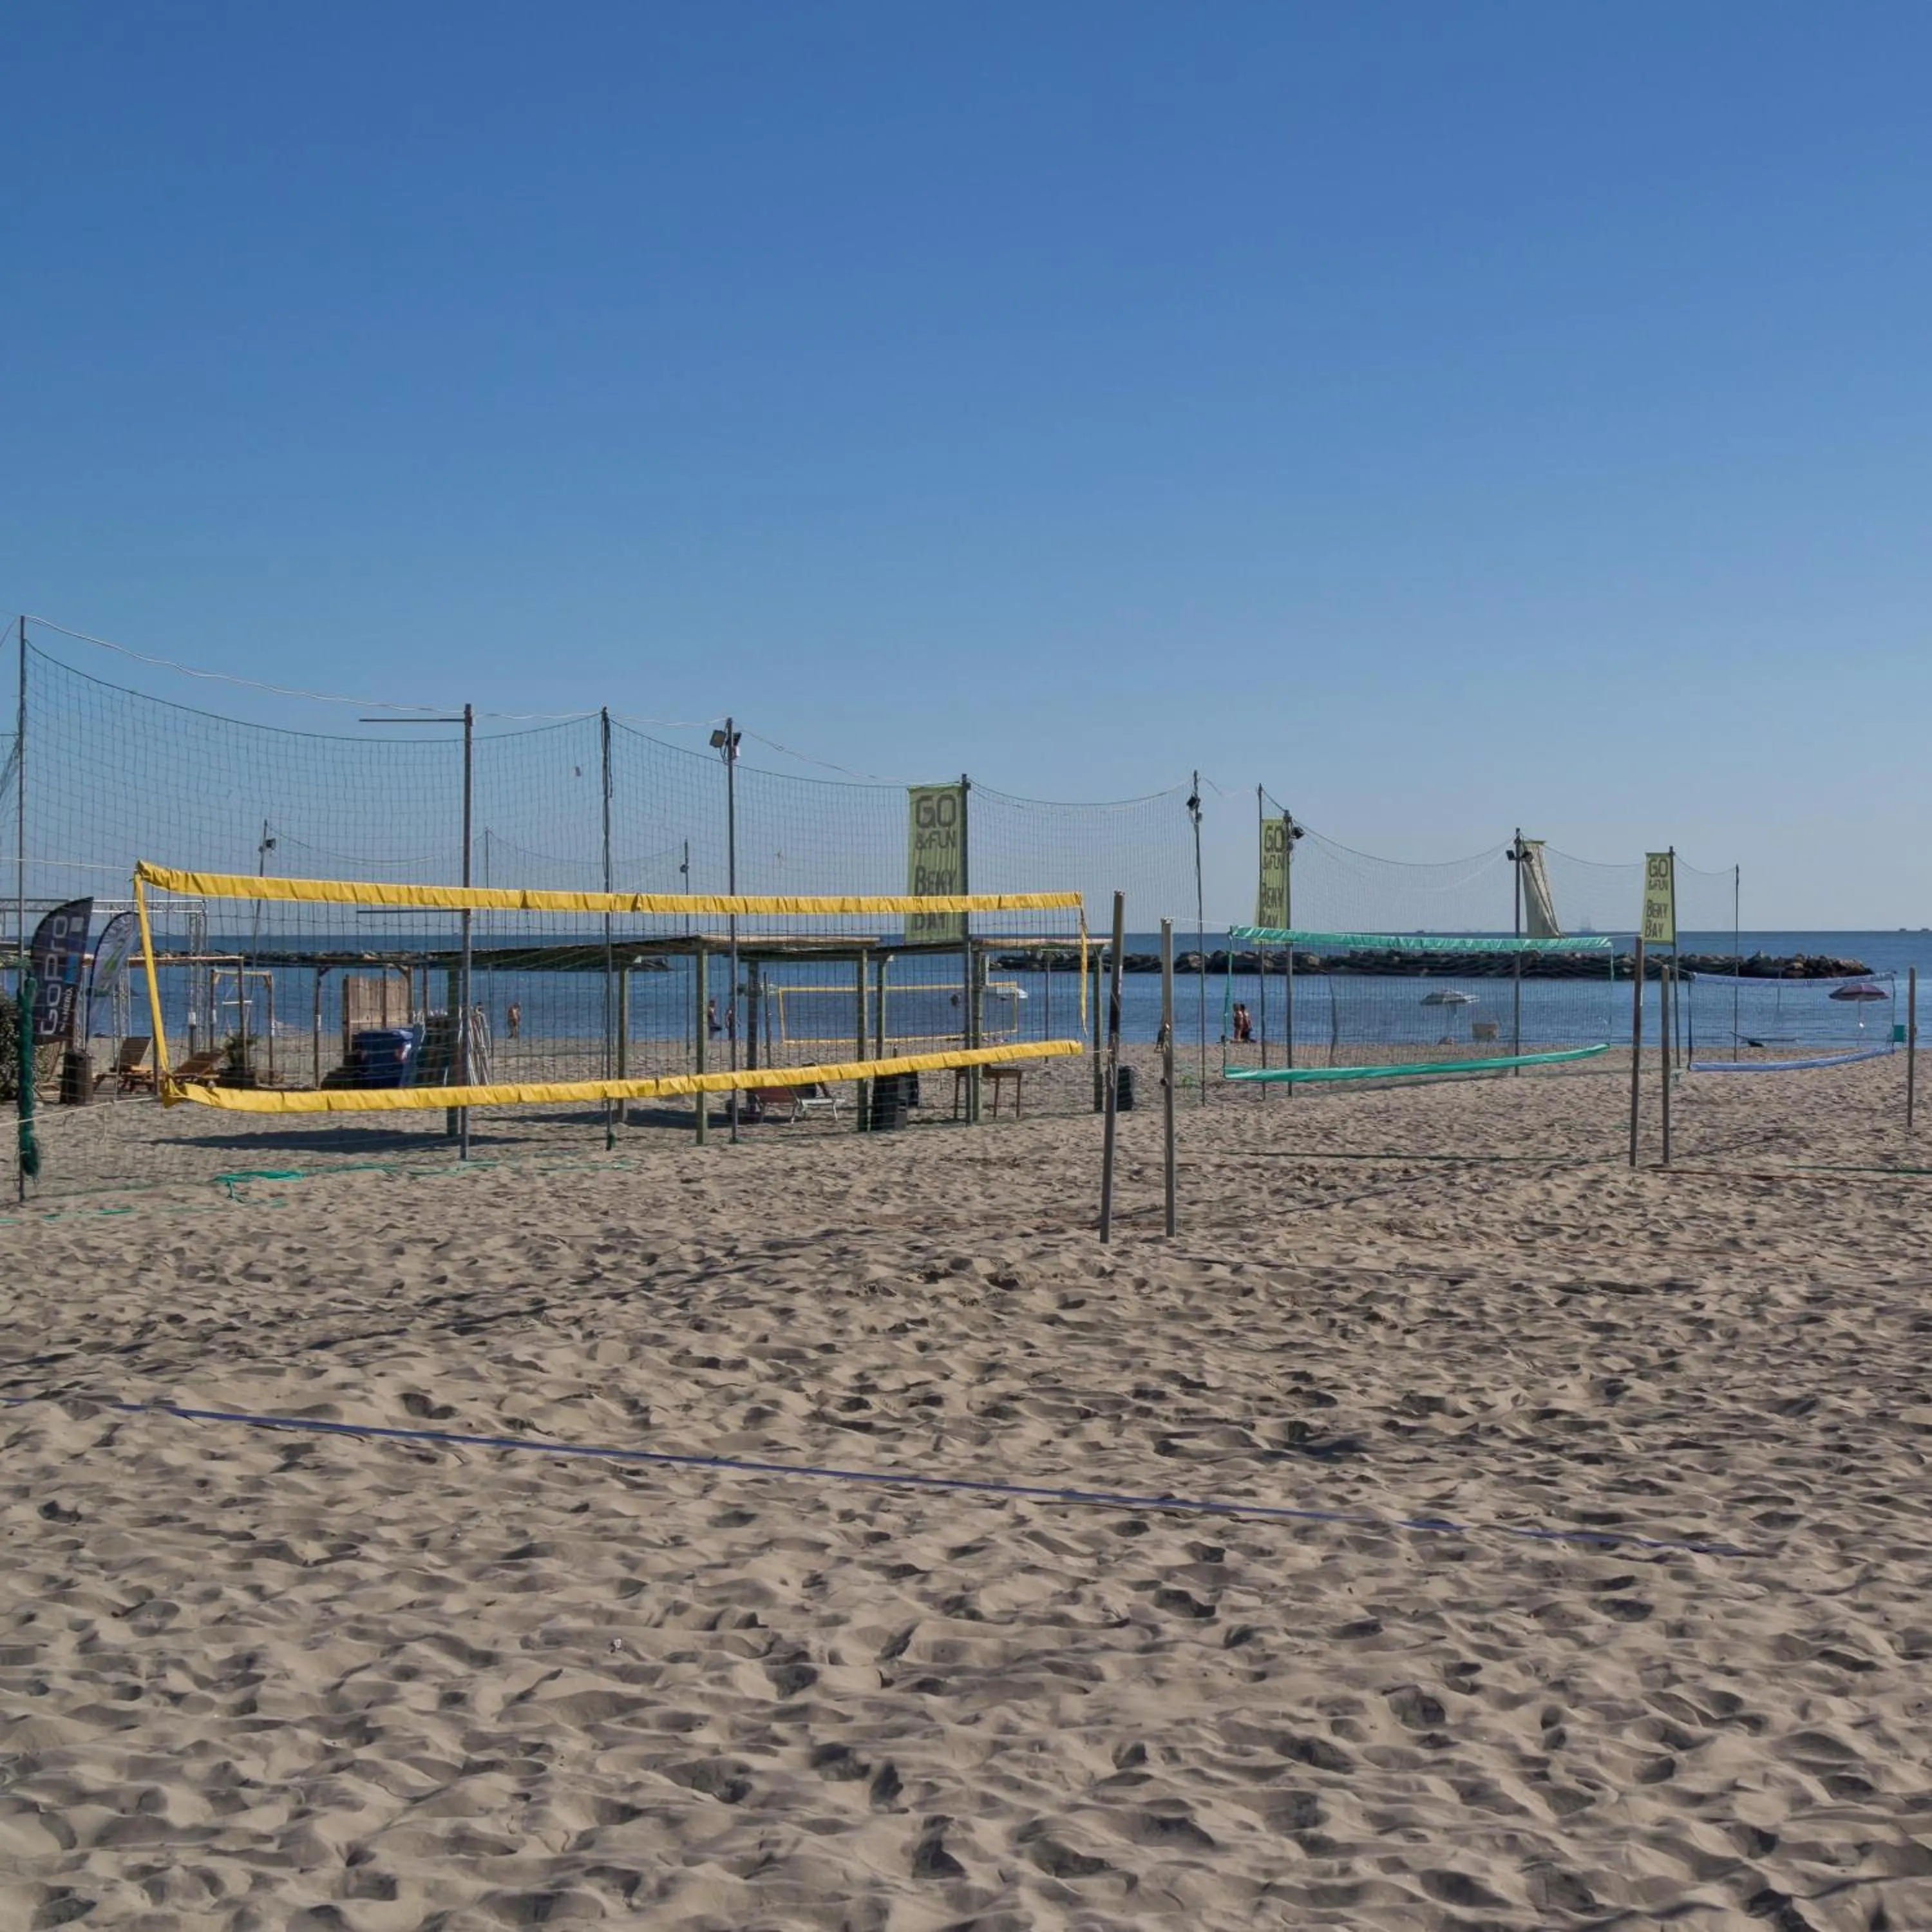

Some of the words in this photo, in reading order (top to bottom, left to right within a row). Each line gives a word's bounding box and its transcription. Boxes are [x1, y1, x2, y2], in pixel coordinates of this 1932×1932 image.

[916, 795, 956, 828] GO
[1265, 826, 1285, 852] GO
[1648, 858, 1669, 878] GO
[1645, 919, 1664, 938] BAY
[40, 916, 69, 1035] GoPro
